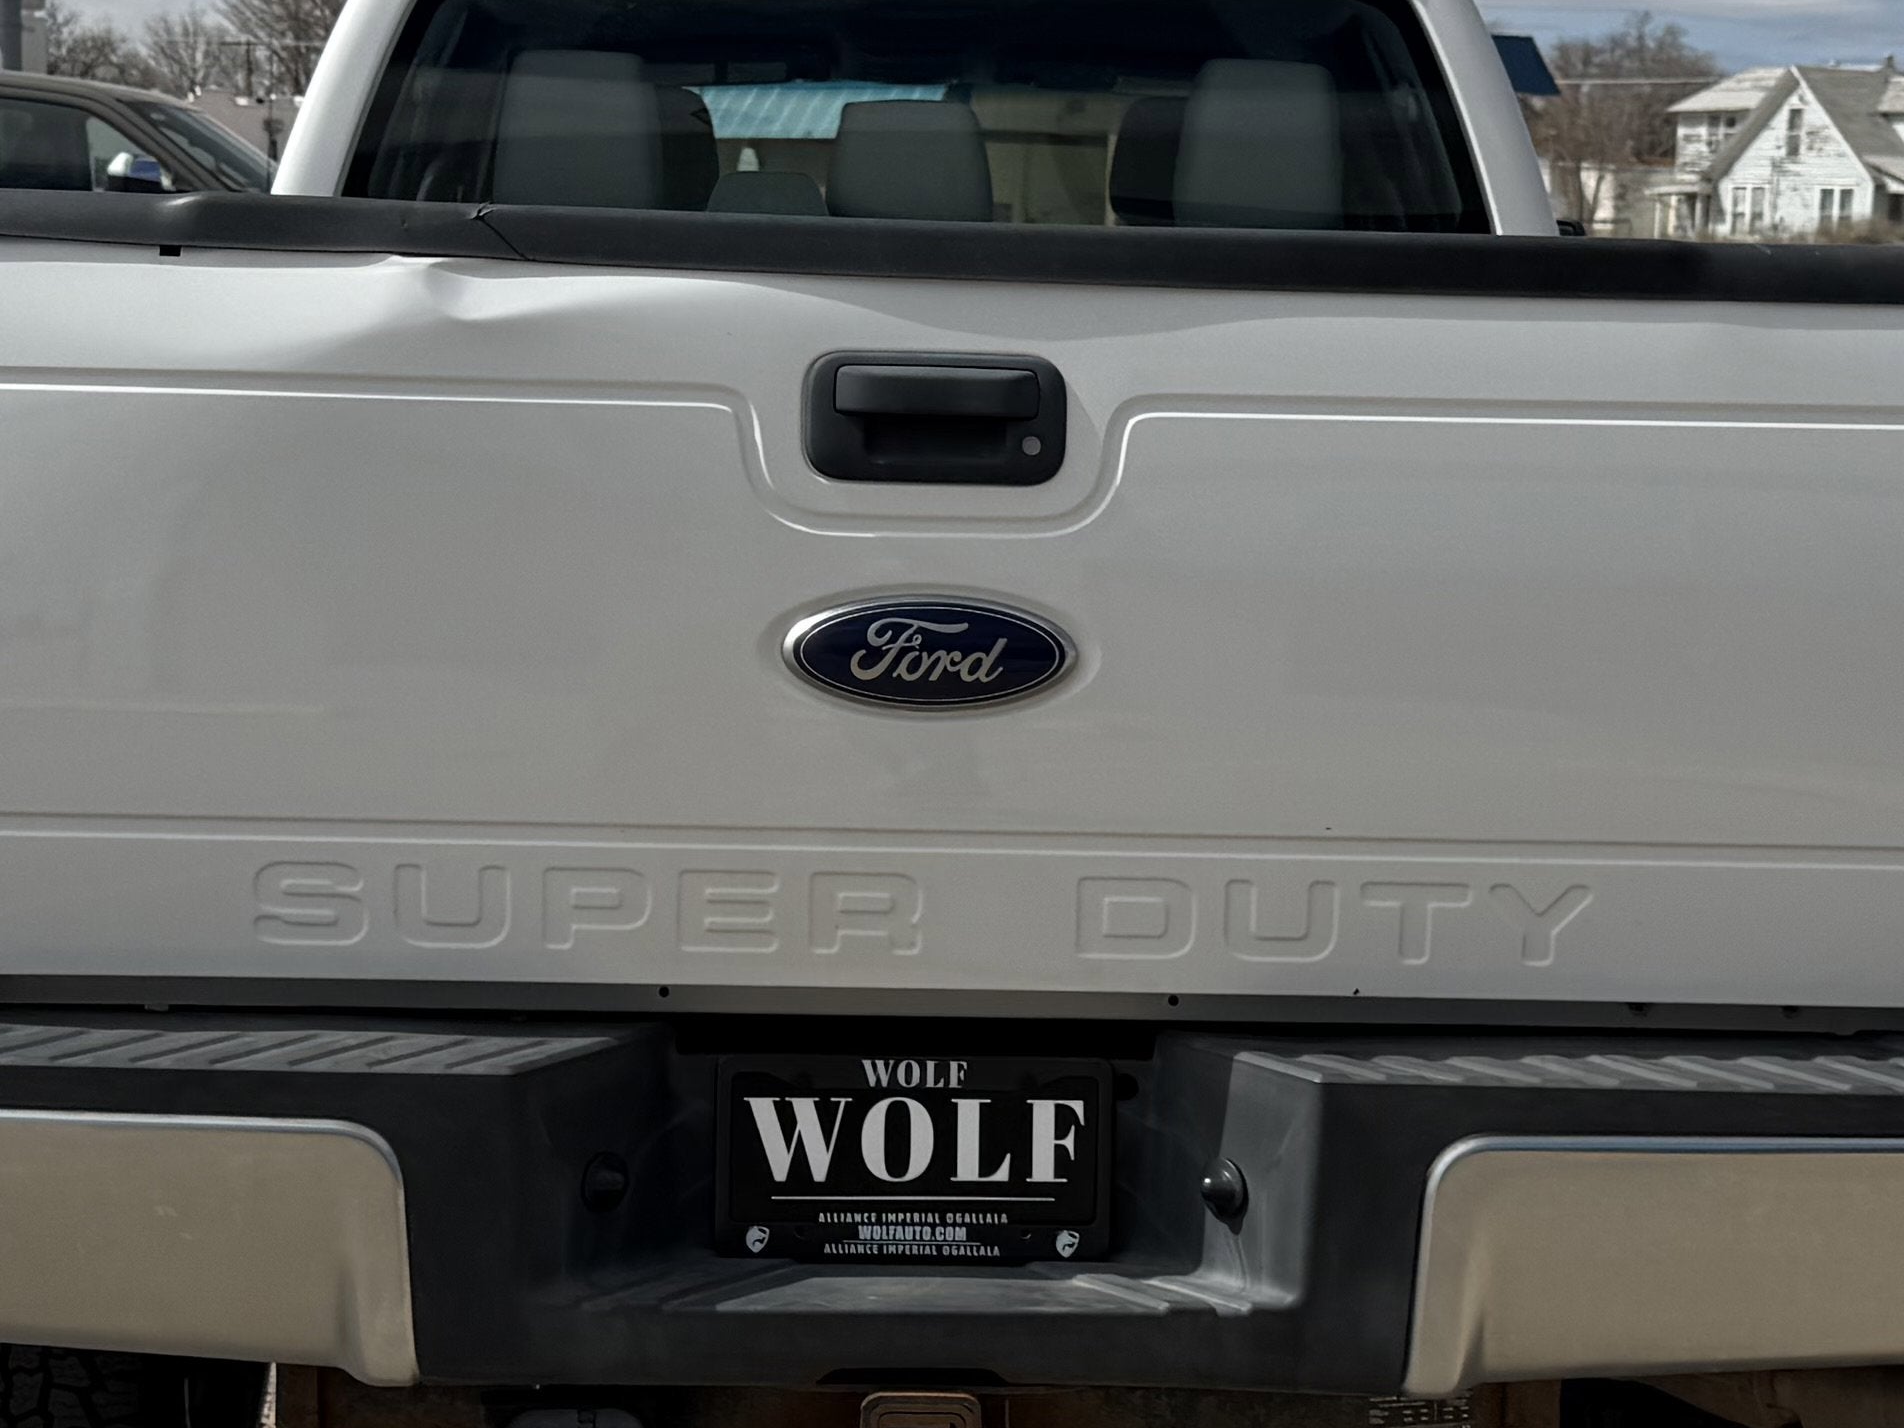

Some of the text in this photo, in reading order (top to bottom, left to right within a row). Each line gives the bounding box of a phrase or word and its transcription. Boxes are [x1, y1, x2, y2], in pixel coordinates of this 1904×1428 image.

[849, 617, 1008, 684] Ford
[252, 860, 1595, 967] SUPER DUTY
[861, 1058, 968, 1089] WOLF
[743, 1096, 1086, 1183] WOLF
[818, 1212, 1008, 1225] ALLIANCE IMPERIAL OGALLALA
[857, 1225, 967, 1241] WOLFAUTO.COM
[823, 1243, 1001, 1257] ALLIANCE IMPERIAL OGALLALA
